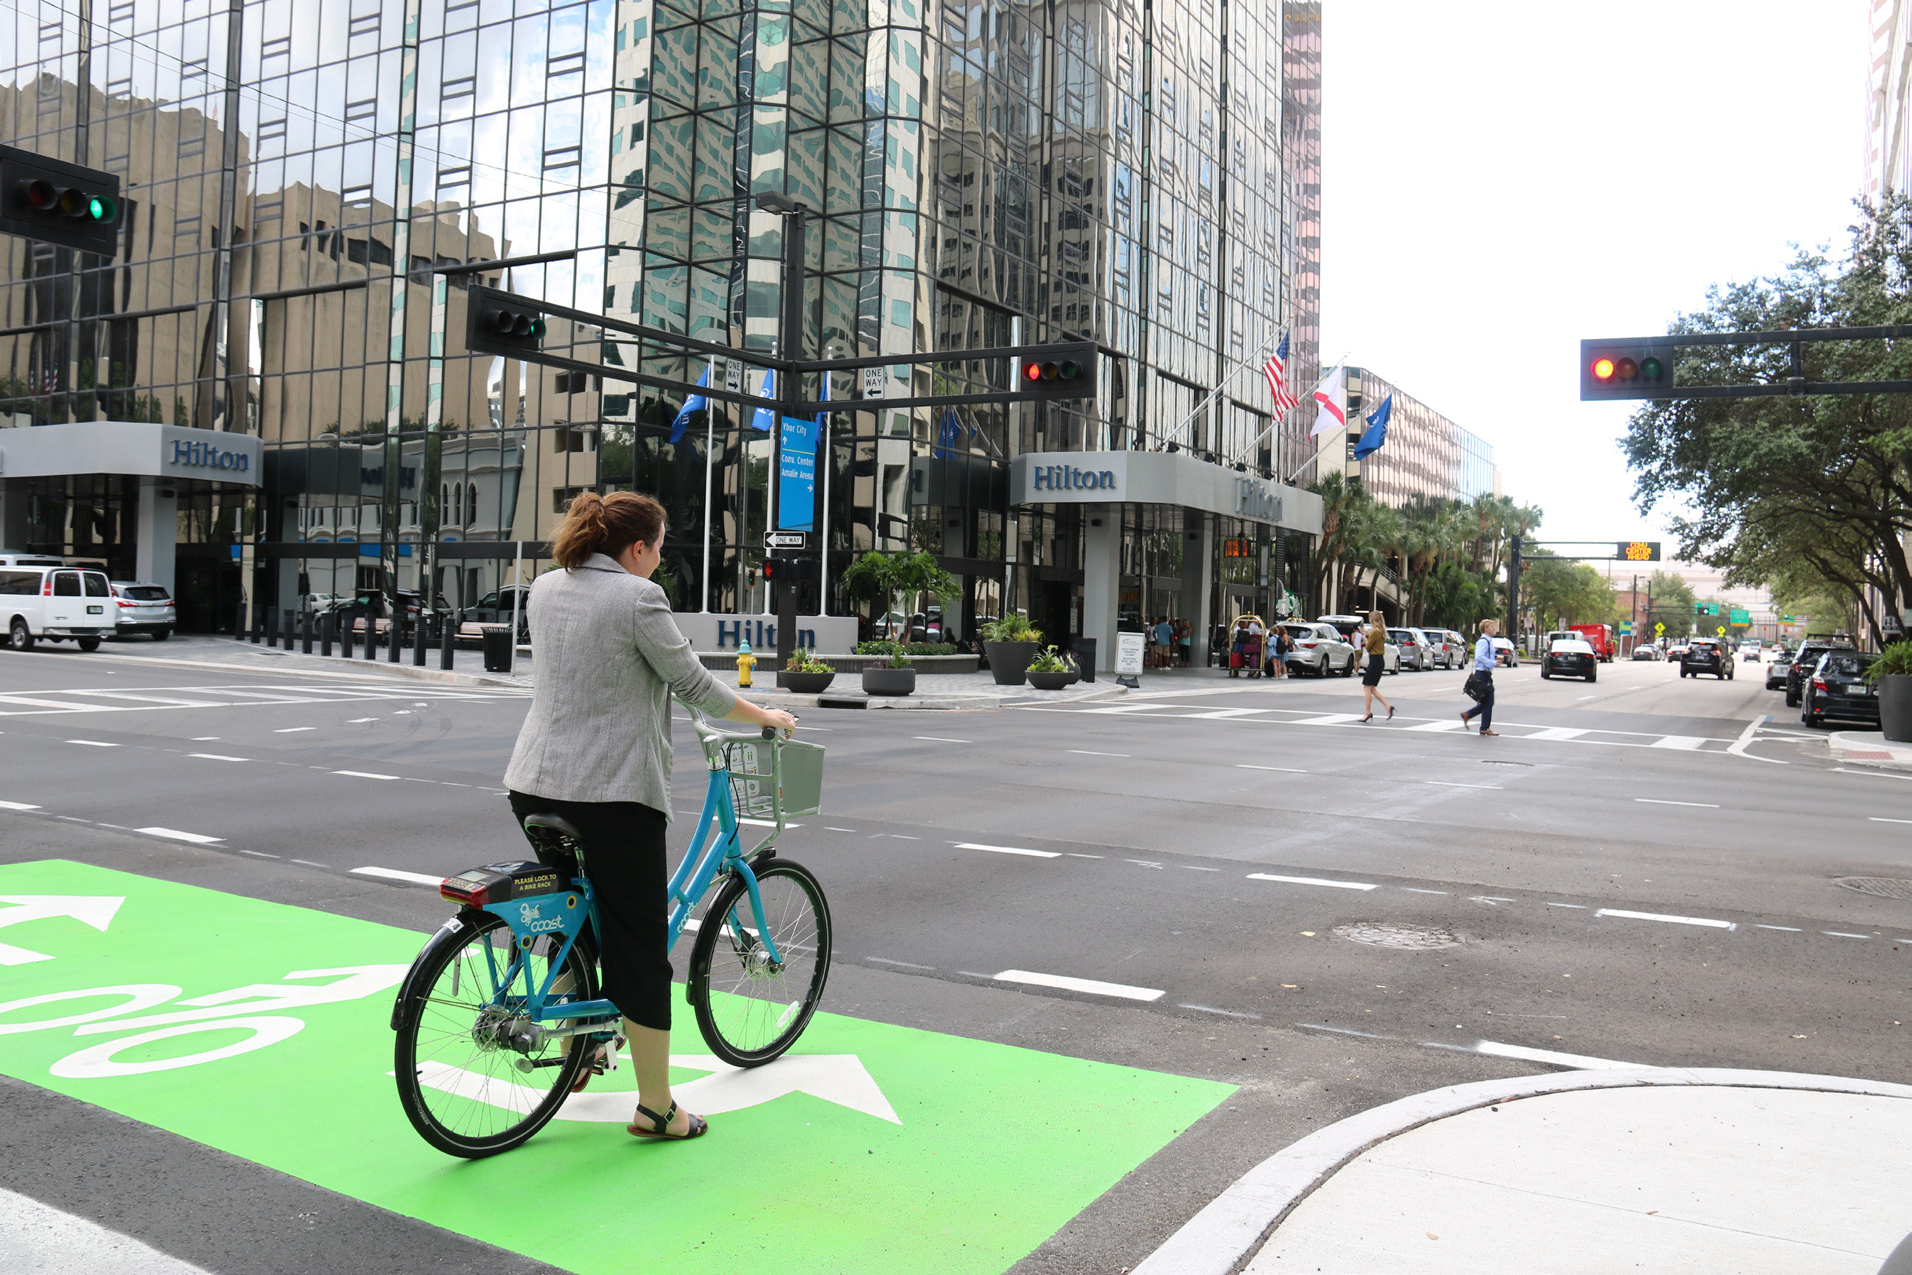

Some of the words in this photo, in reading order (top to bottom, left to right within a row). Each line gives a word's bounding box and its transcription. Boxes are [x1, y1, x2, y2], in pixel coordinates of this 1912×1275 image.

[728, 361, 740, 370] ONE
[728, 371, 740, 379] WAY
[866, 369, 881, 377] ONE
[866, 378, 882, 386] WAY
[783, 423, 795, 432] Ybor
[797, 425, 807, 436] City
[170, 440, 249, 471] Hilton
[782, 454, 796, 463] Conv.
[797, 457, 814, 466] Center
[782, 468, 798, 478] Amalie
[800, 470, 814, 480] Arena
[1034, 465, 1115, 489] Hilton
[1235, 477, 1283, 521] Hilton
[776, 536, 788, 544] ONE
[1625, 547, 1652, 555] CENTER
[717, 620, 816, 648] Hiltn
[514, 877, 534, 885] PLEASE
[530, 914, 565, 933] coast
